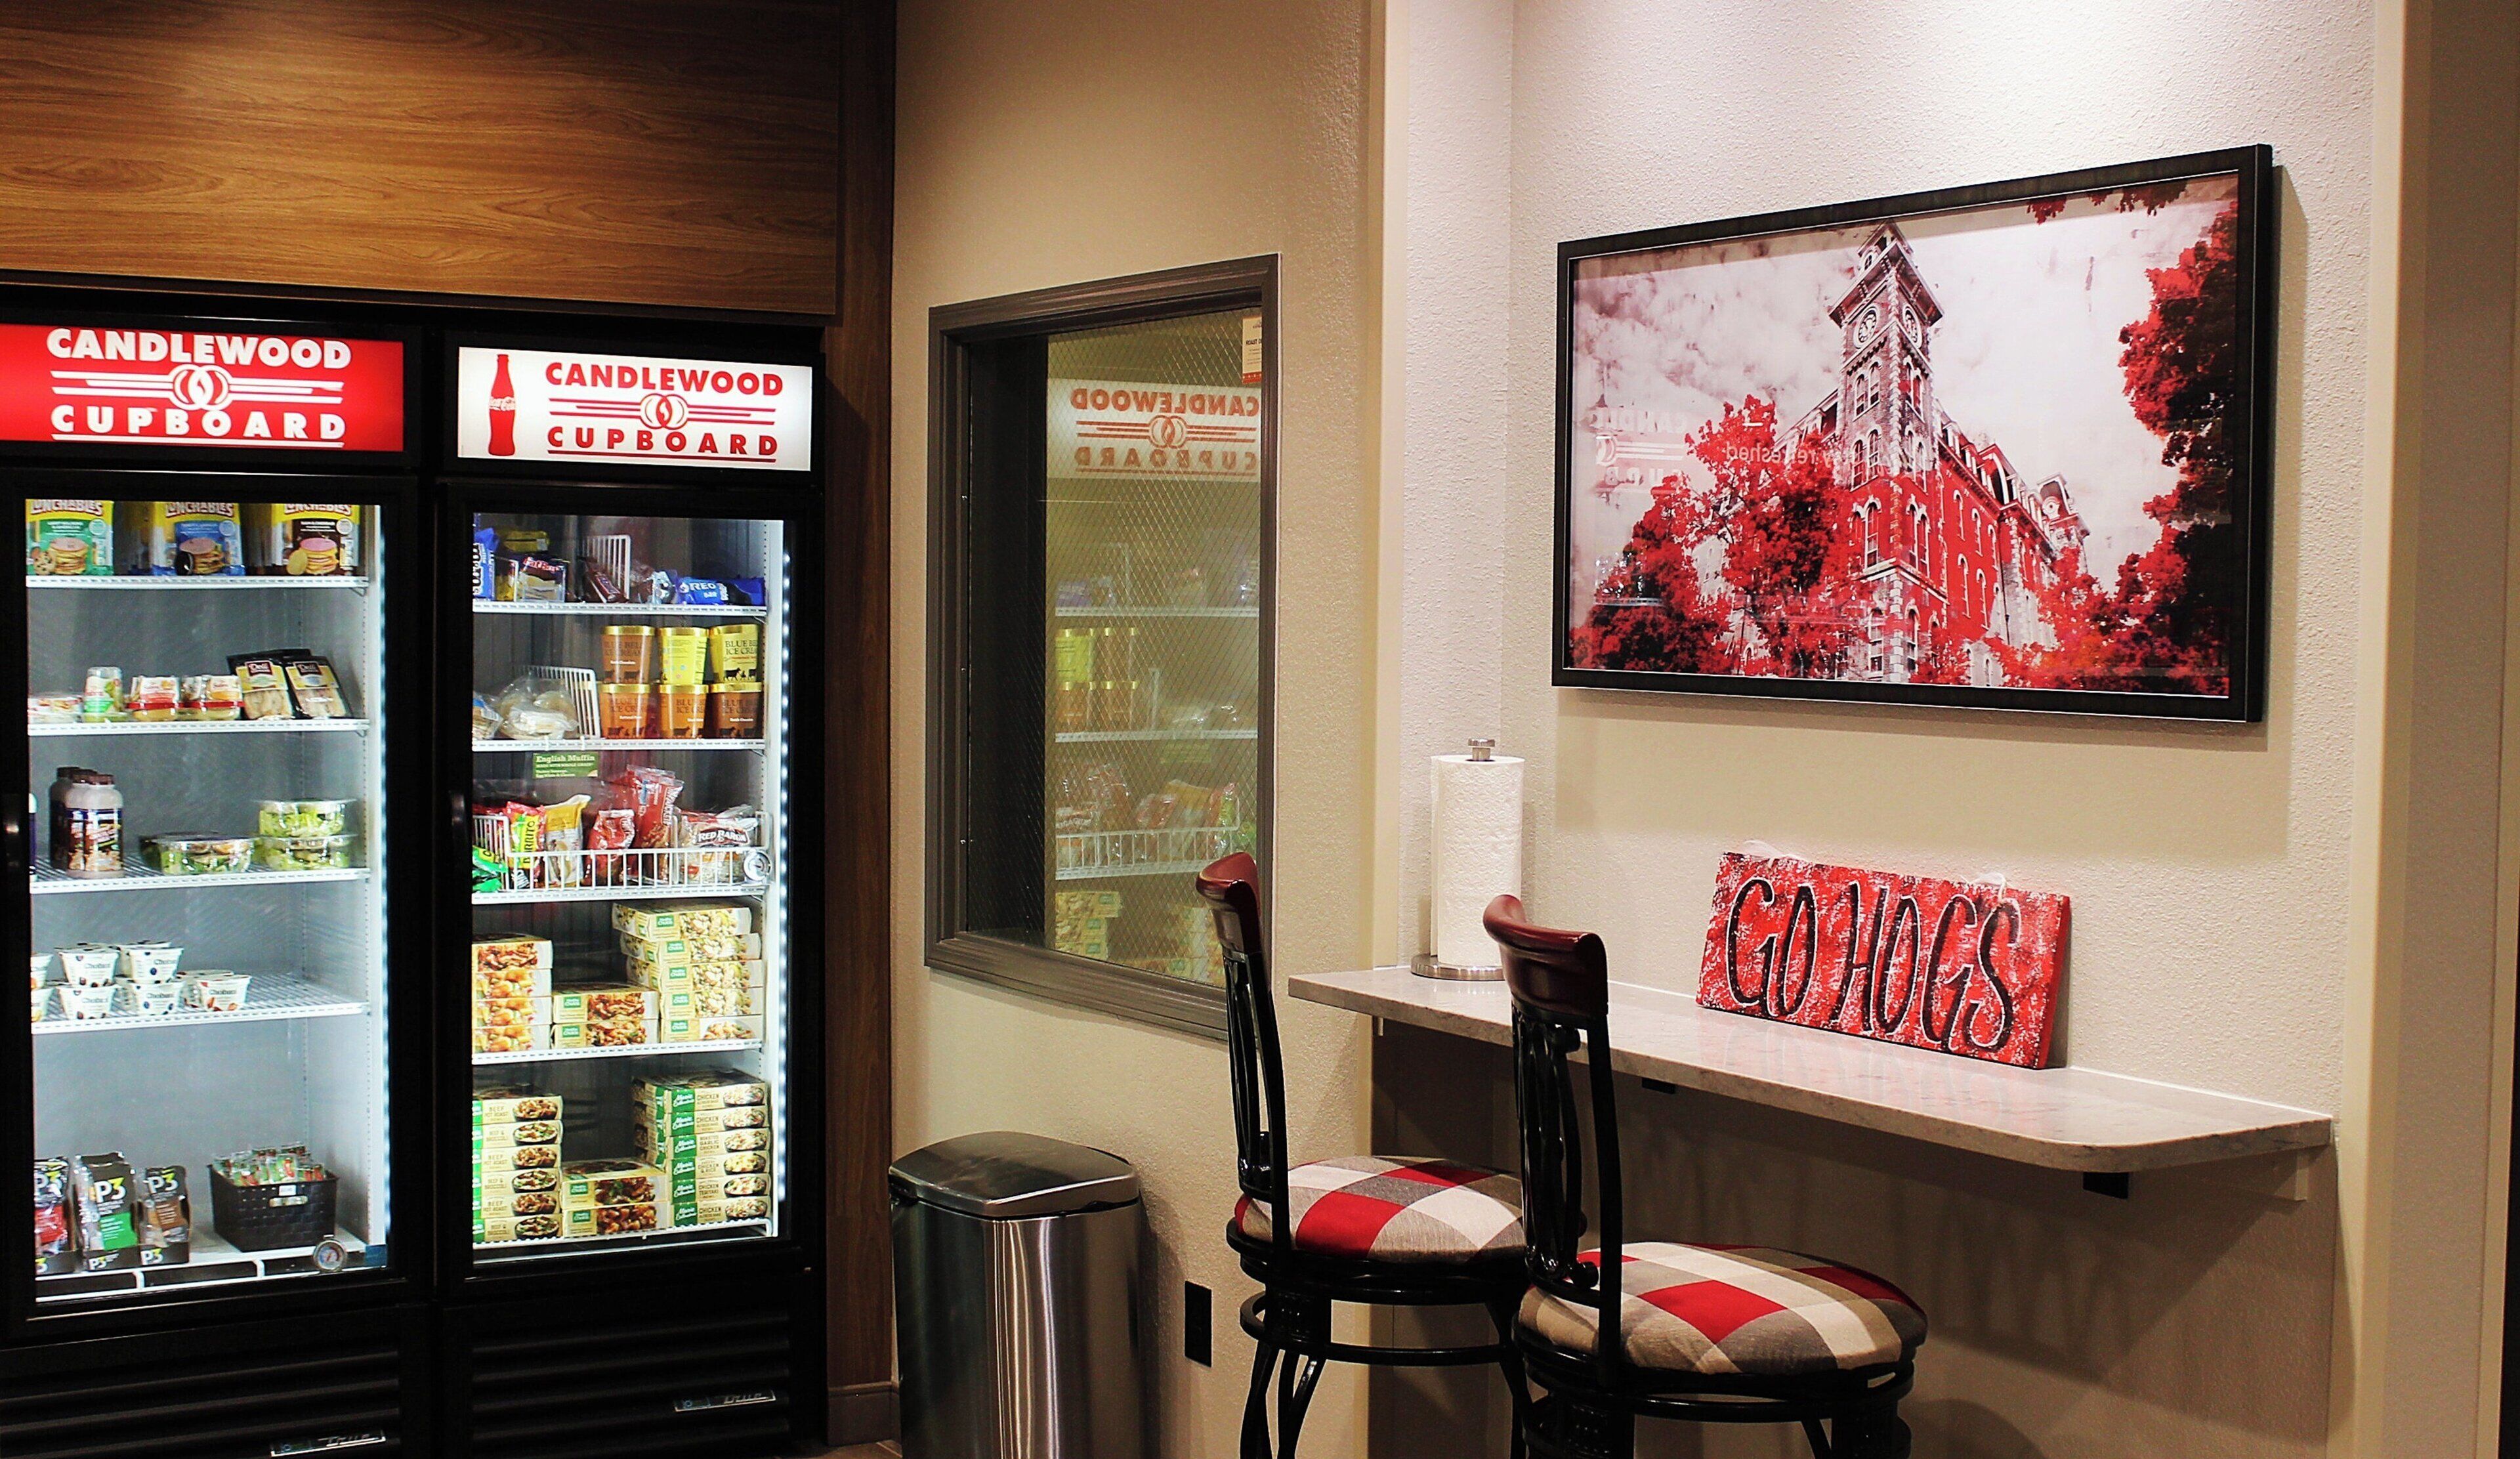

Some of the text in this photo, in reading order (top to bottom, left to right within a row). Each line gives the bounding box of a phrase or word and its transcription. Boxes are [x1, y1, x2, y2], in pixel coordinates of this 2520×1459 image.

[47, 328, 352, 370] CANDLEWOOD
[545, 362, 784, 396] CANDLEWOOD
[51, 405, 346, 439] CUPBOARD
[547, 426, 778, 455] CUPBOARD
[679, 581, 716, 593] OREO
[523, 820, 536, 864] BRRITO
[698, 831, 717, 842] RED
[1726, 877, 2023, 1053] GO HOGS
[94, 1176, 127, 1204] P3
[148, 1172, 179, 1195] P3
[35, 1257, 49, 1273] 3
[89, 1256, 107, 1271] P3
[140, 1248, 164, 1265] P3
